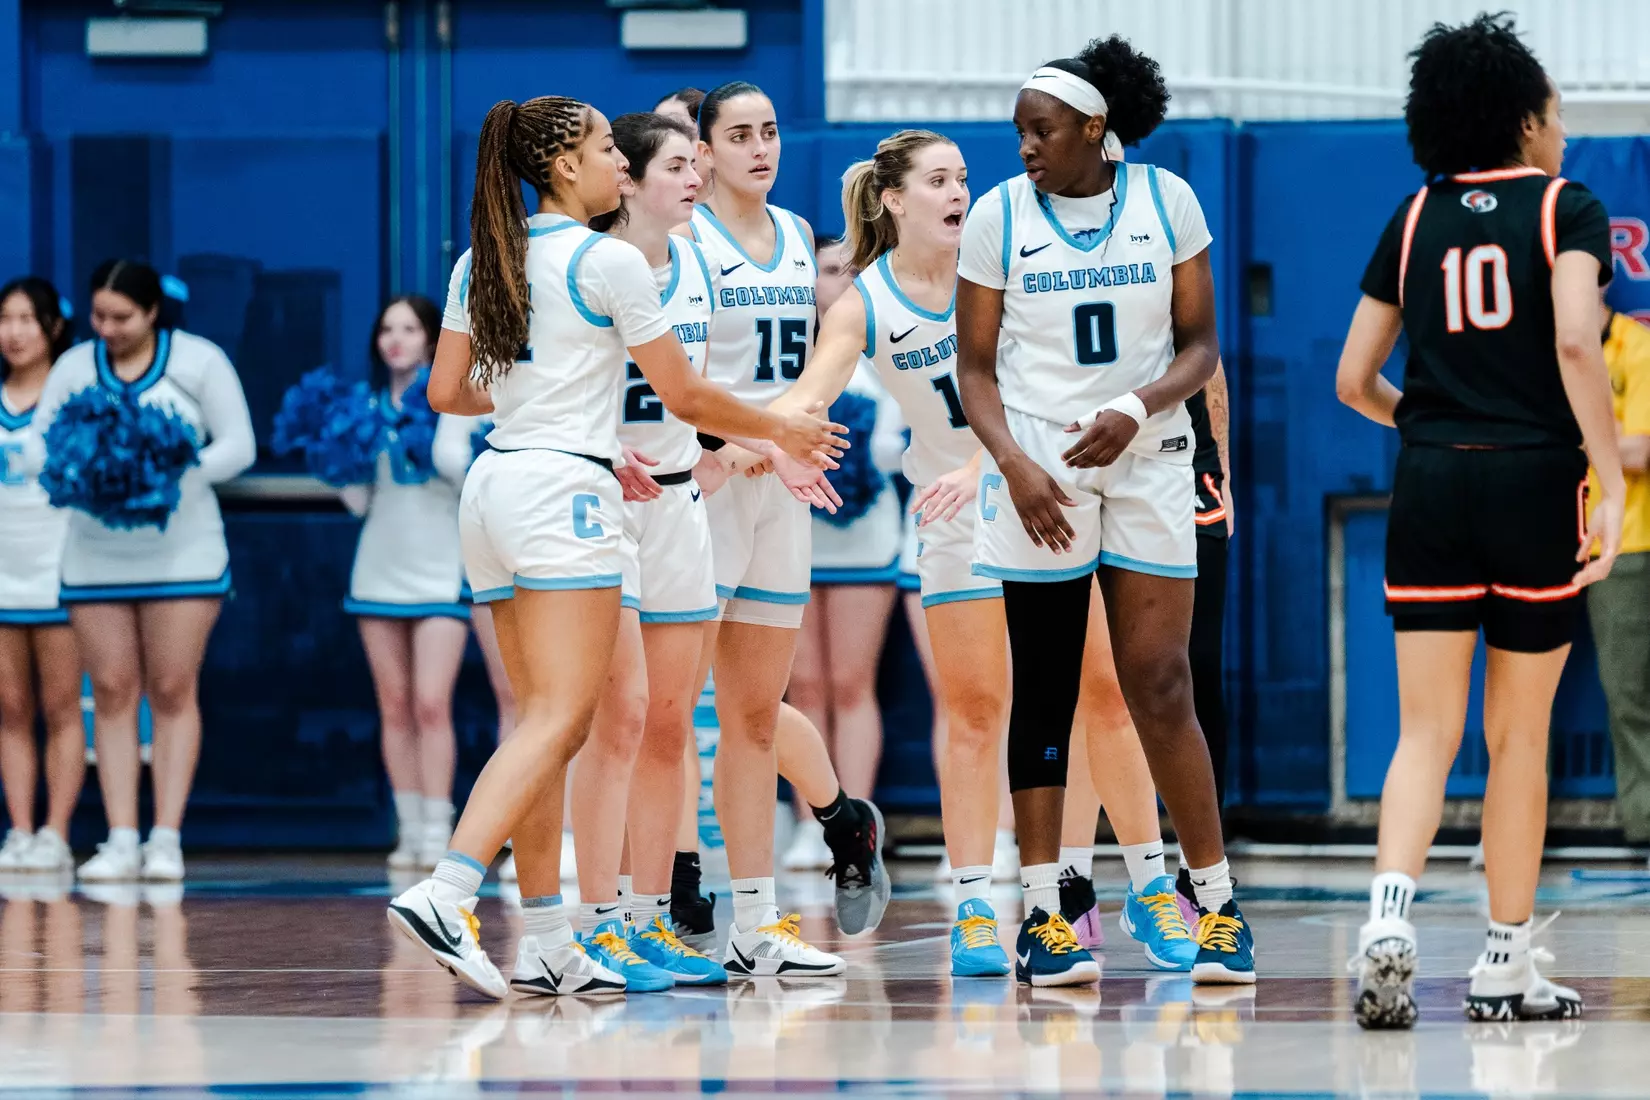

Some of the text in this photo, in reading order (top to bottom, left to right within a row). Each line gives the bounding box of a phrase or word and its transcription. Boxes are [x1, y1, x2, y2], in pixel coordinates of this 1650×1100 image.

[1023, 262, 1157, 293] COLUMBIA
[1440, 244, 1513, 333] 10
[753, 317, 807, 383] 15
[1071, 300, 1119, 367] 0
[572, 493, 605, 540] C
[981, 472, 1003, 522] C
